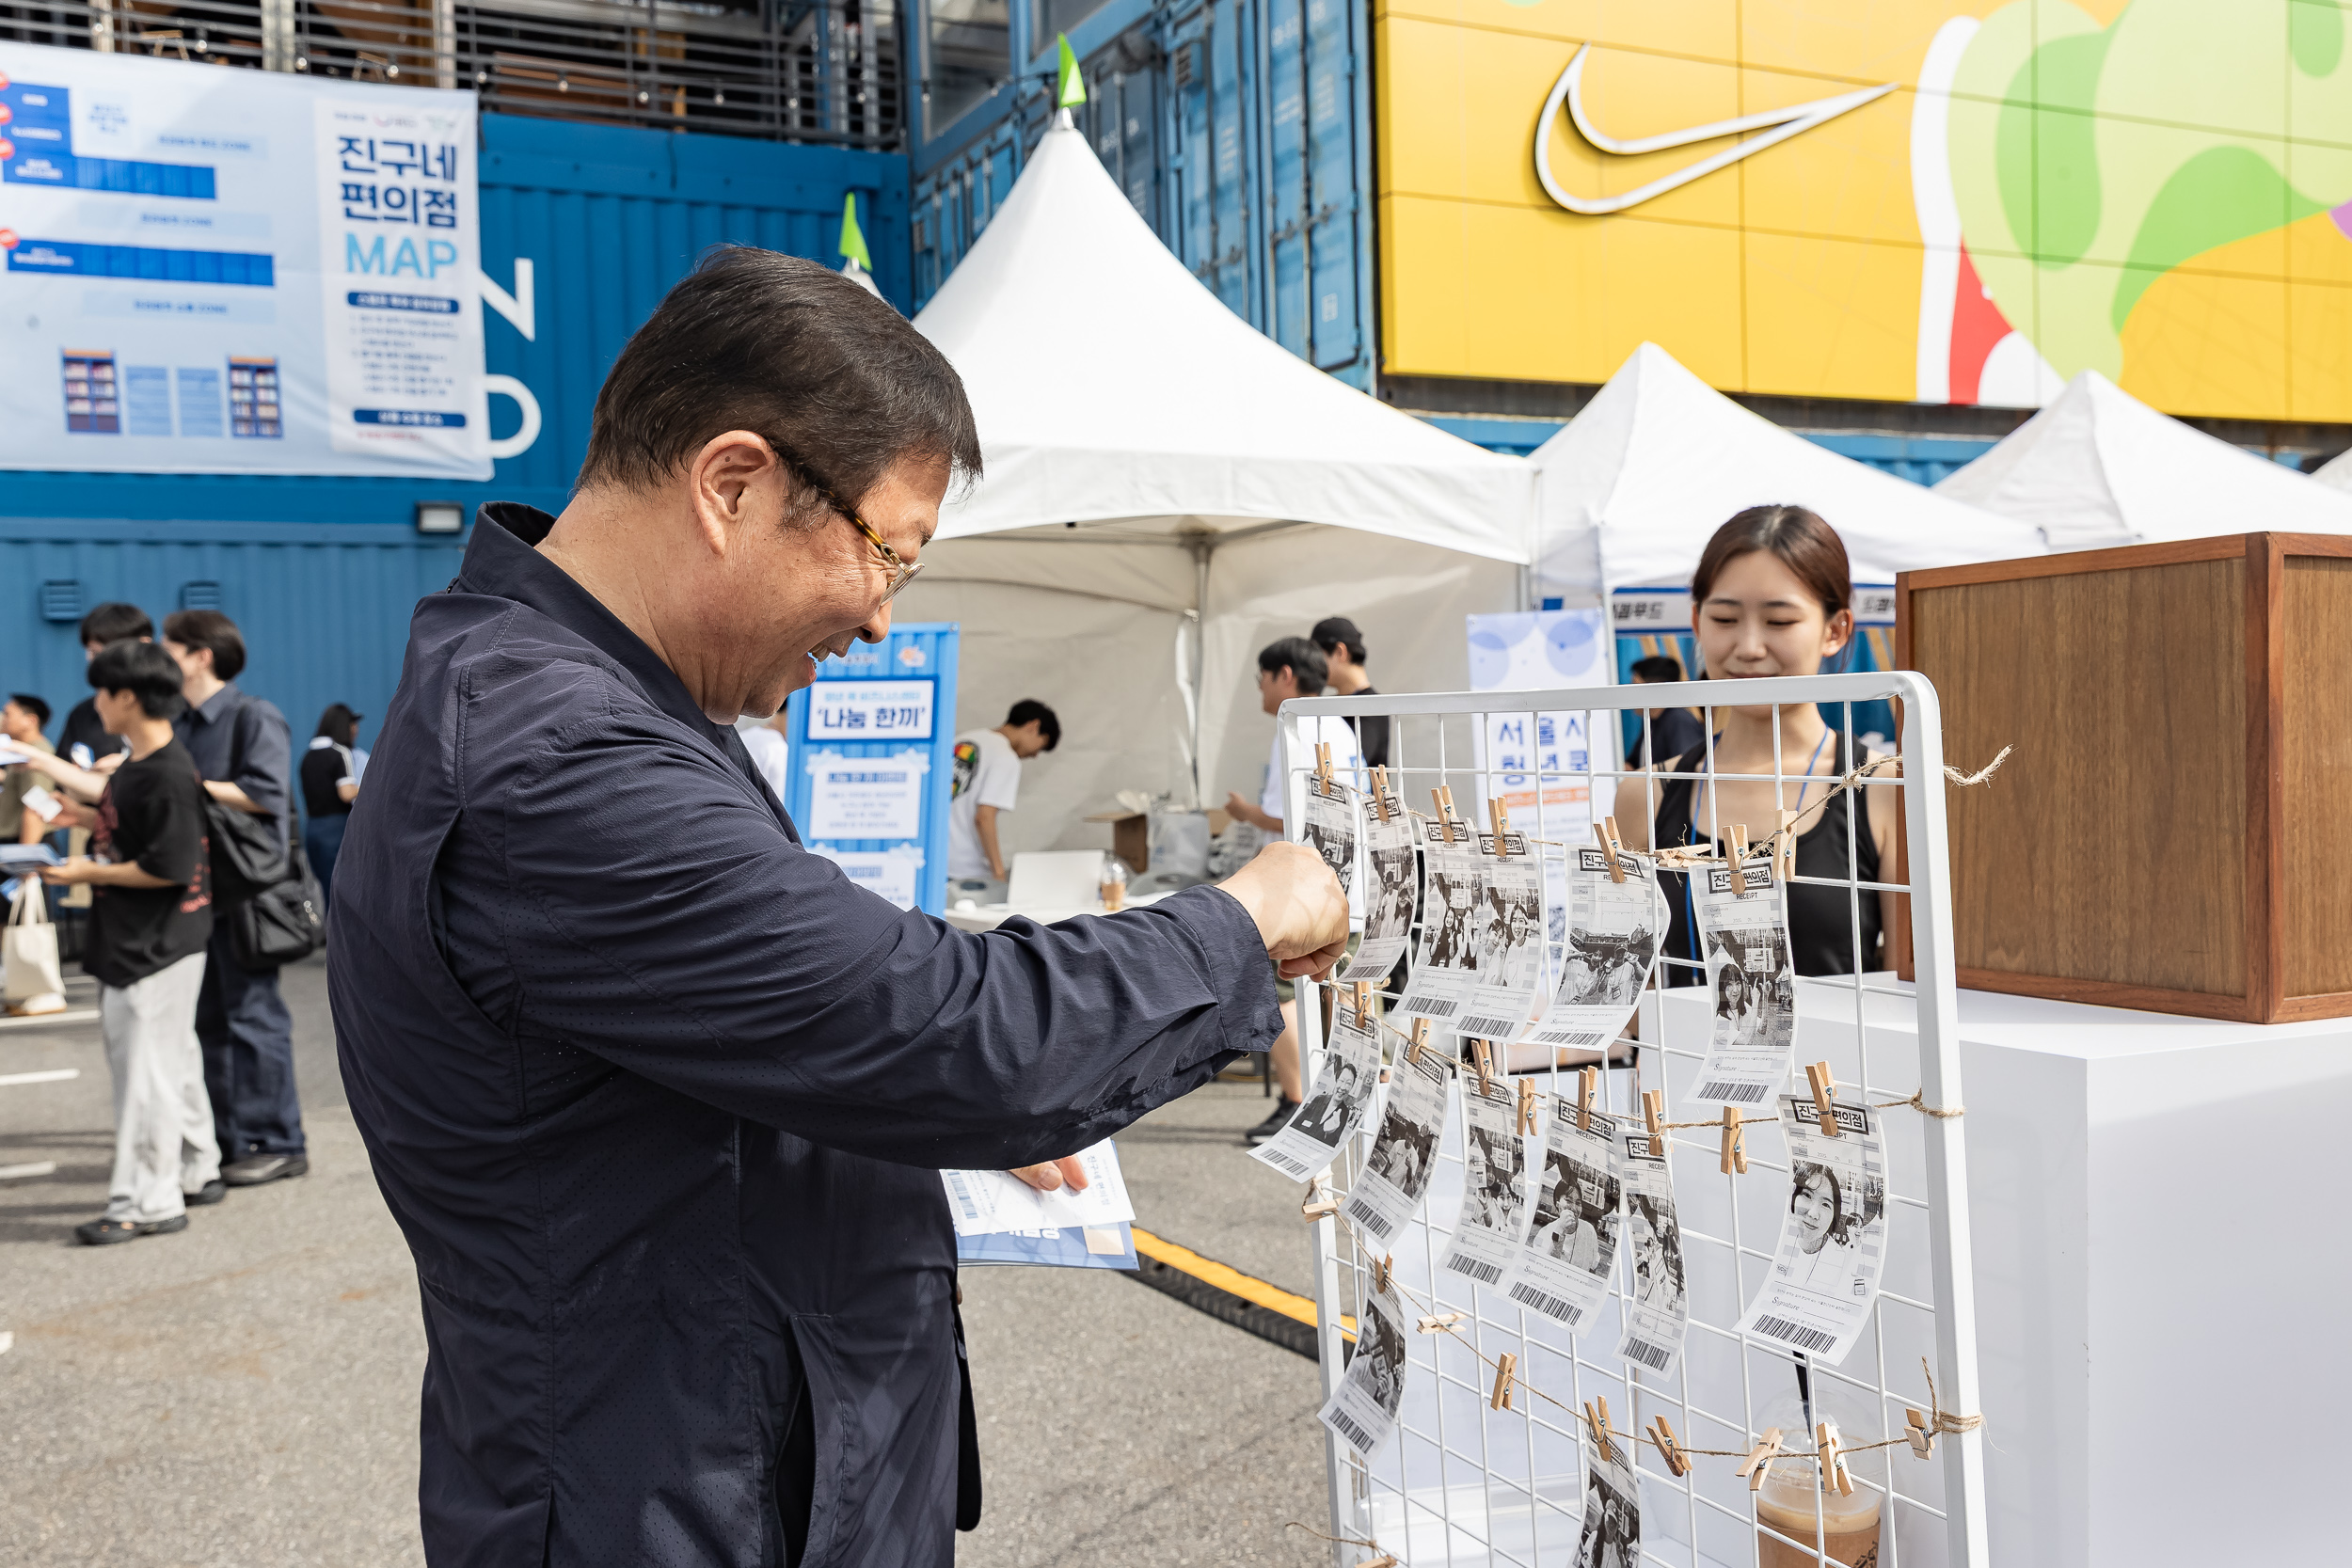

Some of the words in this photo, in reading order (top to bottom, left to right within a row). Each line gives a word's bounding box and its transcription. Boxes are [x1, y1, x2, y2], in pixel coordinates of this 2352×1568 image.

[338, 136, 457, 181] 진구네
[341, 182, 458, 229] 편의점
[345, 232, 457, 278] MAP
[1736, 892, 1758, 900] RECEIPT
[1713, 1063, 1738, 1071] Signature
[1562, 1105, 1578, 1121] 진구
[1575, 1129, 1597, 1143] RECEIPT
[1523, 1265, 1549, 1281] Signature
[1772, 1296, 1800, 1312] Signature
